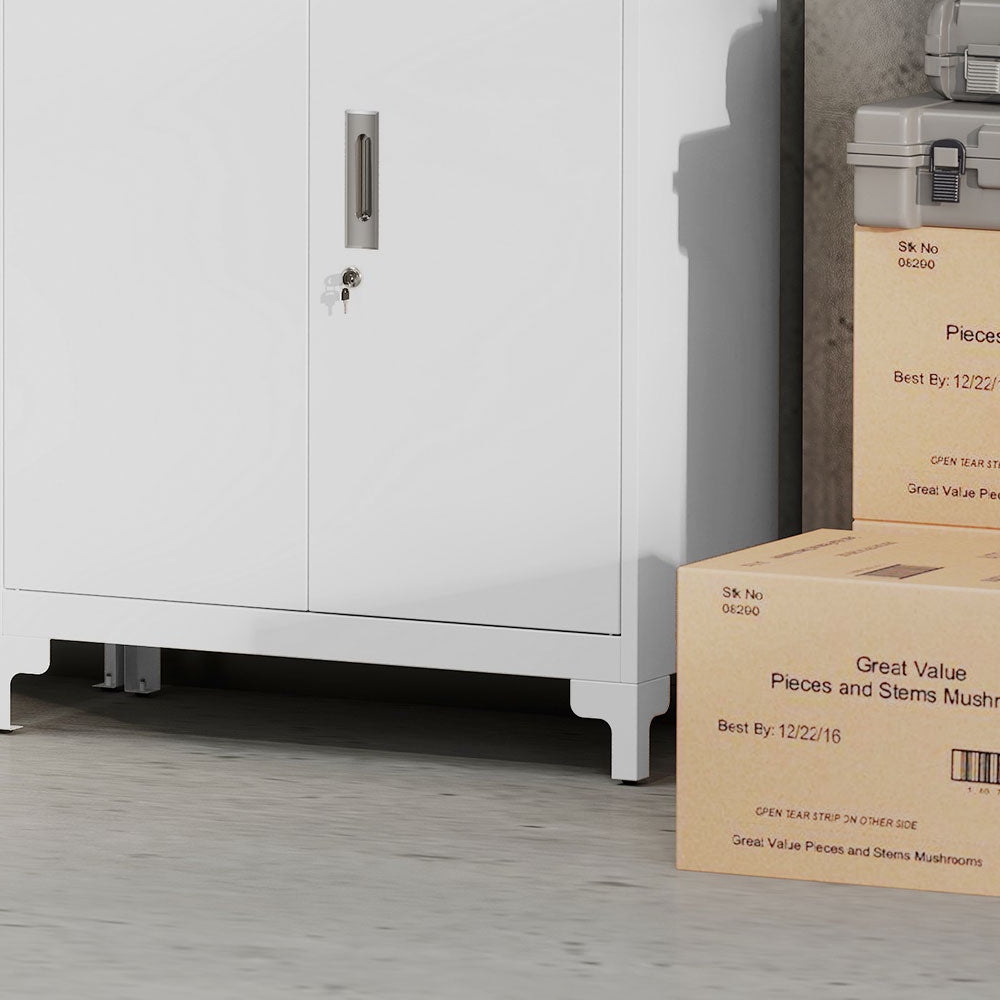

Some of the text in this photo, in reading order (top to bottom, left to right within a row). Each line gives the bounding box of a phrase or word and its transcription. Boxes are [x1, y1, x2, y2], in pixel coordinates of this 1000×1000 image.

[920, 242, 939, 255] No
[893, 370, 1000, 392] Best By: 12/22/
[960, 457, 985, 468] TEAR
[986, 459, 1000, 469] ST
[745, 588, 764, 601] No
[856, 655, 967, 682] Great Value
[771, 672, 833, 694] Pieces
[838, 681, 873, 698] and
[878, 681, 937, 704] Stems
[717, 718, 842, 744] Best By: 12/22/16
[785, 809, 811, 820] TEAR
[812, 811, 841, 823] STRIP
[859, 815, 894, 828] OTHER
[895, 818, 918, 831] SIDE
[732, 834, 765, 848] Great
[767, 837, 802, 851] Value
[847, 846, 871, 858] and
[873, 846, 911, 861] Stems
[914, 850, 983, 868] Mushrooms
